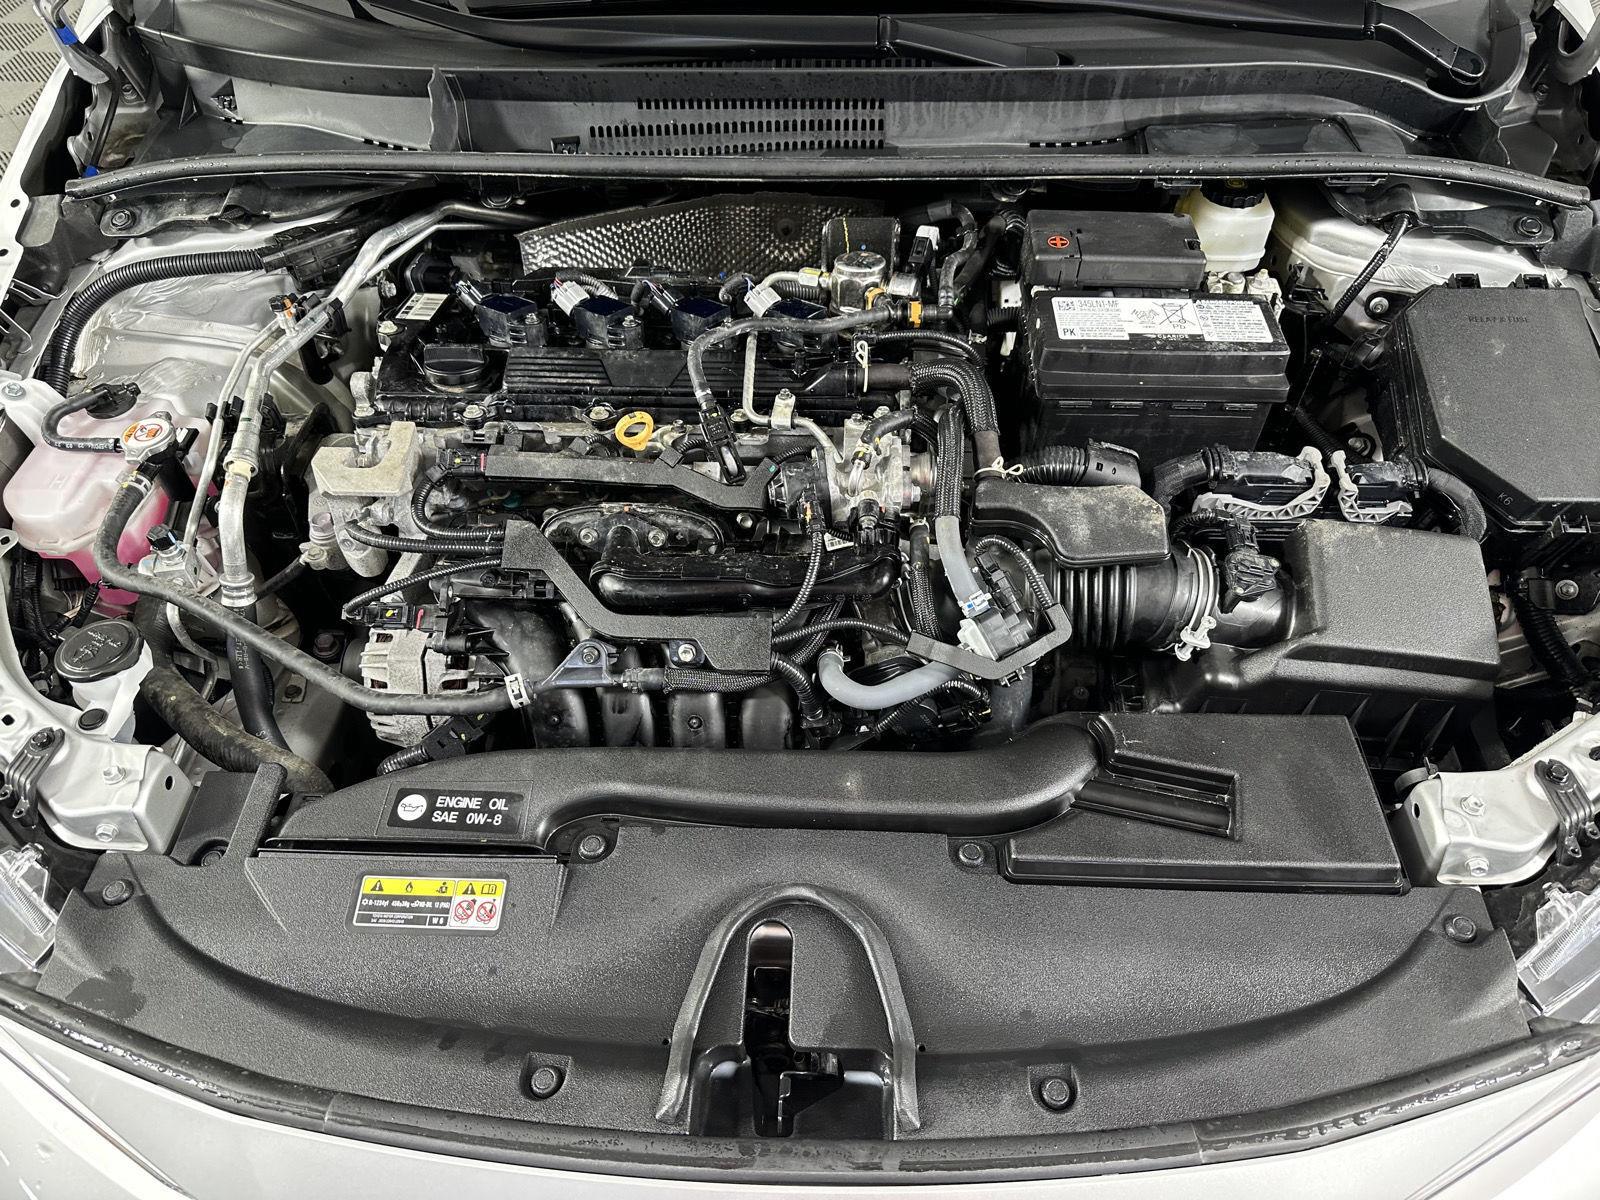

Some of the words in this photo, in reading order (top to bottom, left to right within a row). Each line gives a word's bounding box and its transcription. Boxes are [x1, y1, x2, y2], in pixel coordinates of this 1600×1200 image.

[1062, 327, 1077, 337] PK
[435, 796, 482, 809] ENGINE
[489, 798, 509, 811] OIL
[431, 811, 459, 823] SAE
[465, 812, 503, 826] 0W-8
